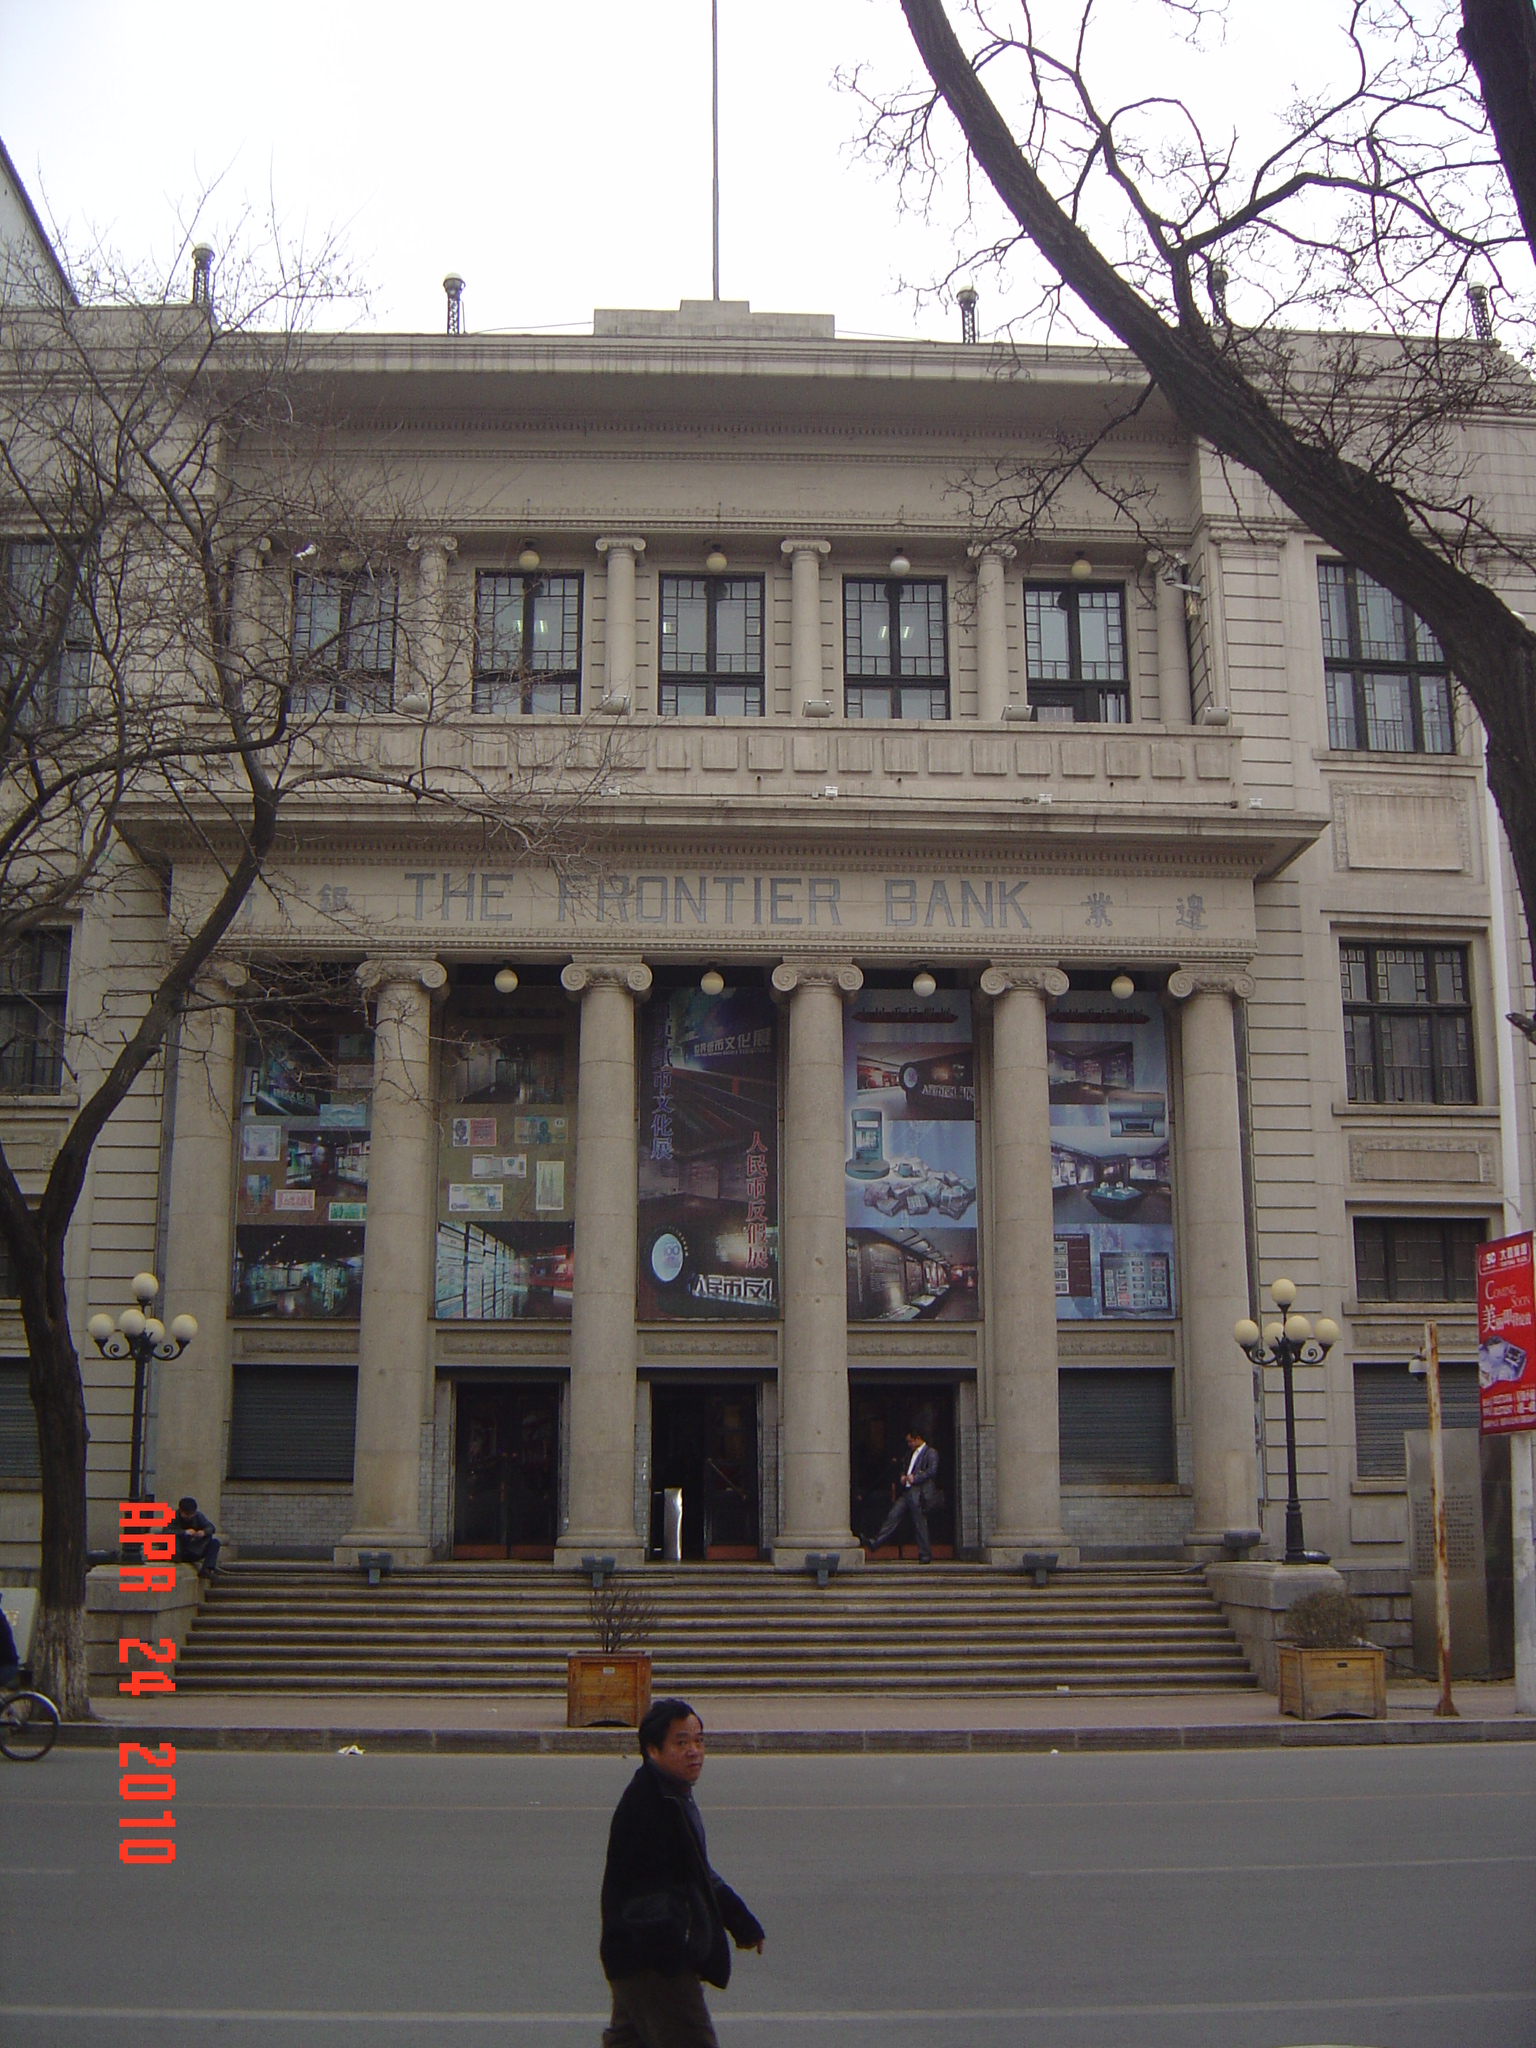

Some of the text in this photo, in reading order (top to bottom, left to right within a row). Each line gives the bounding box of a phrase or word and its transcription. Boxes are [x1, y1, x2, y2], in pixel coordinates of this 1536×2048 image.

[404, 872, 1033, 930] THE FRONTIER BANK
